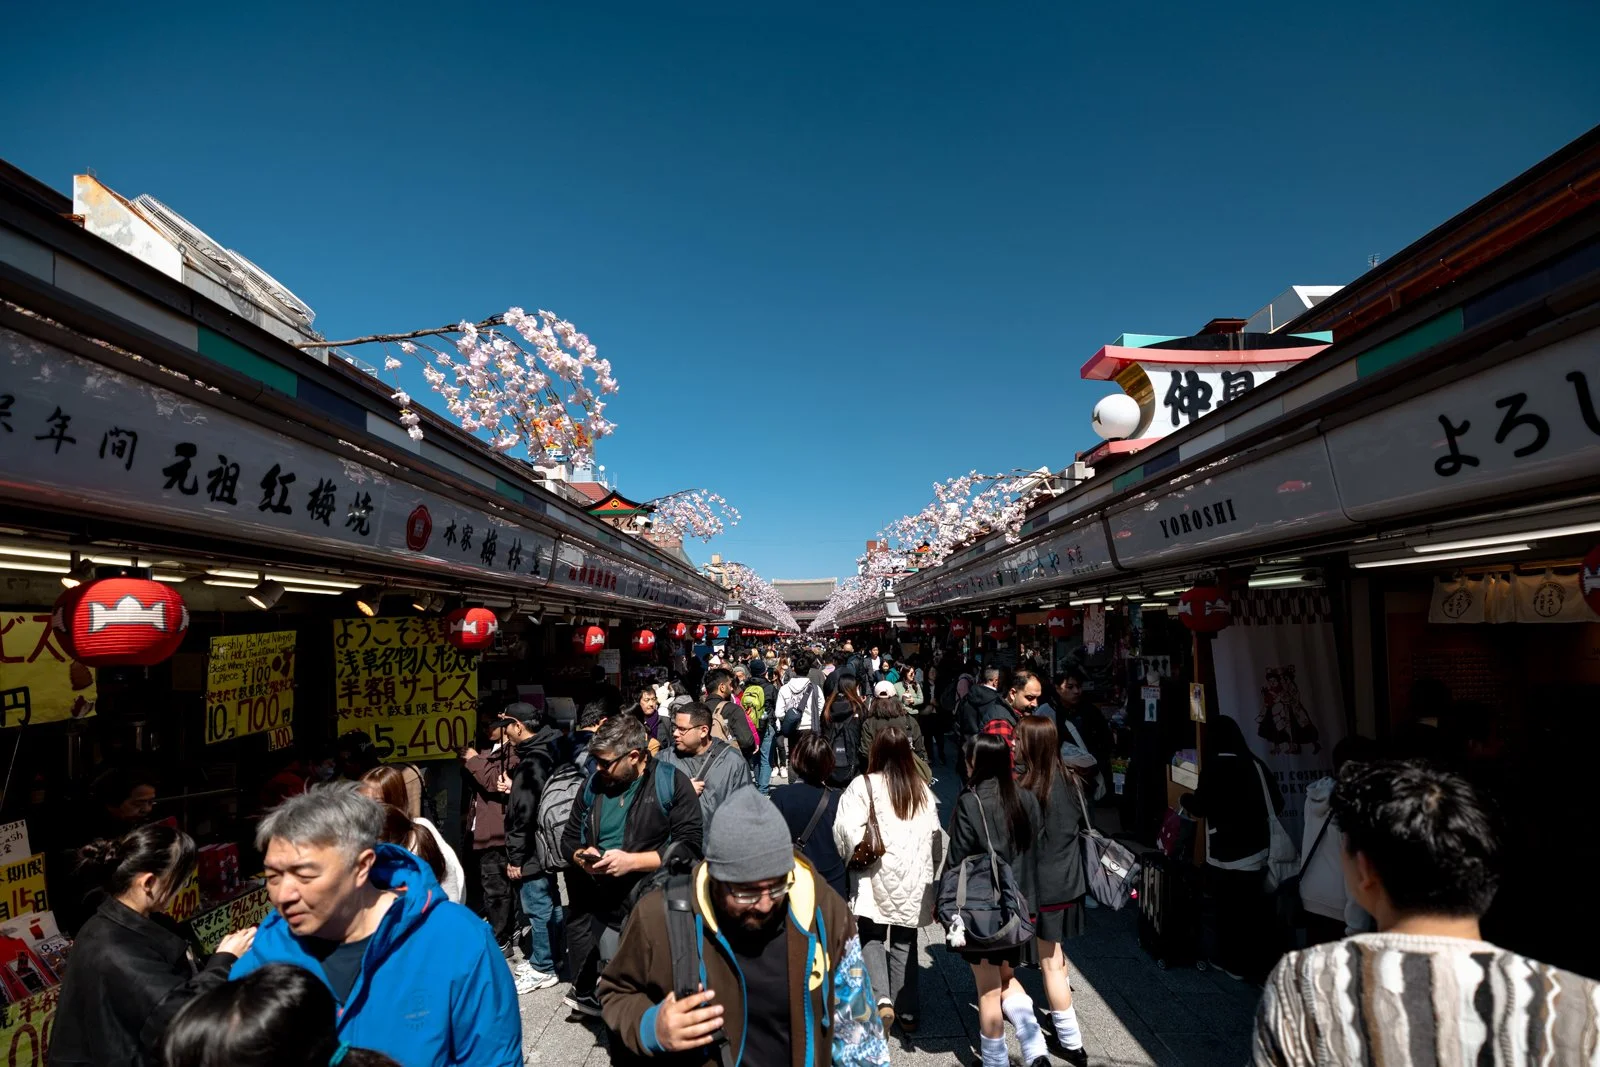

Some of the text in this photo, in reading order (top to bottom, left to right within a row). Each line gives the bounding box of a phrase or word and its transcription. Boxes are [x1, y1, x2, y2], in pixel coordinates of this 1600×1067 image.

[1164, 370, 1286, 426] 仲見
[1159, 499, 1237, 539] YOROSHI
[338, 673, 476, 707] 半額サービス
[0, 858, 43, 884] 期限
